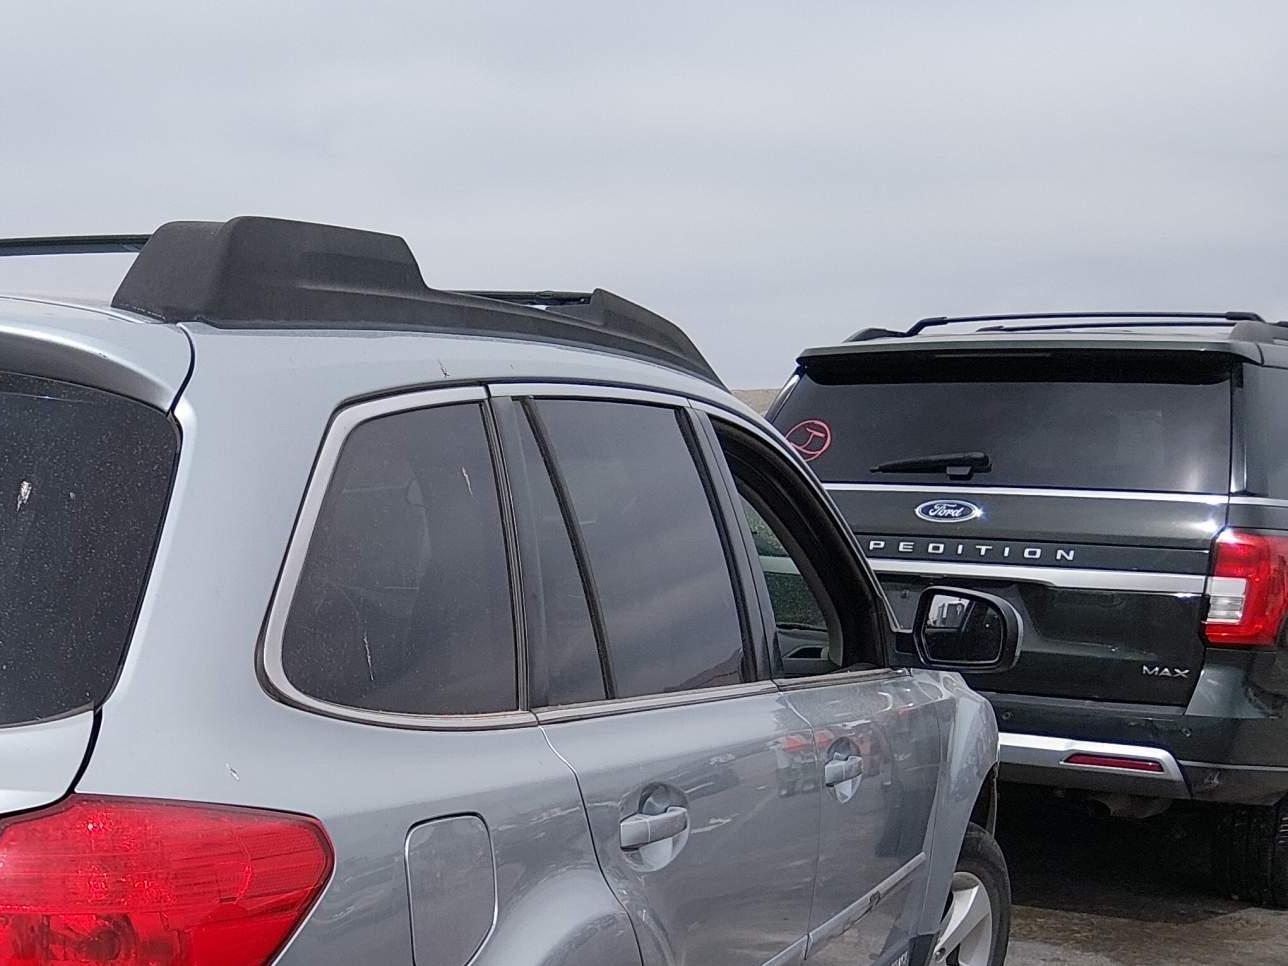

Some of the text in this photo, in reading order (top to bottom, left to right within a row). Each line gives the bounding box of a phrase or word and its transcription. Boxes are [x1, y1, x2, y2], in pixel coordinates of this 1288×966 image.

[928, 503, 964, 517] Ford
[869, 540, 1075, 561] PEDITION
[1142, 665, 1190, 678] MAX
